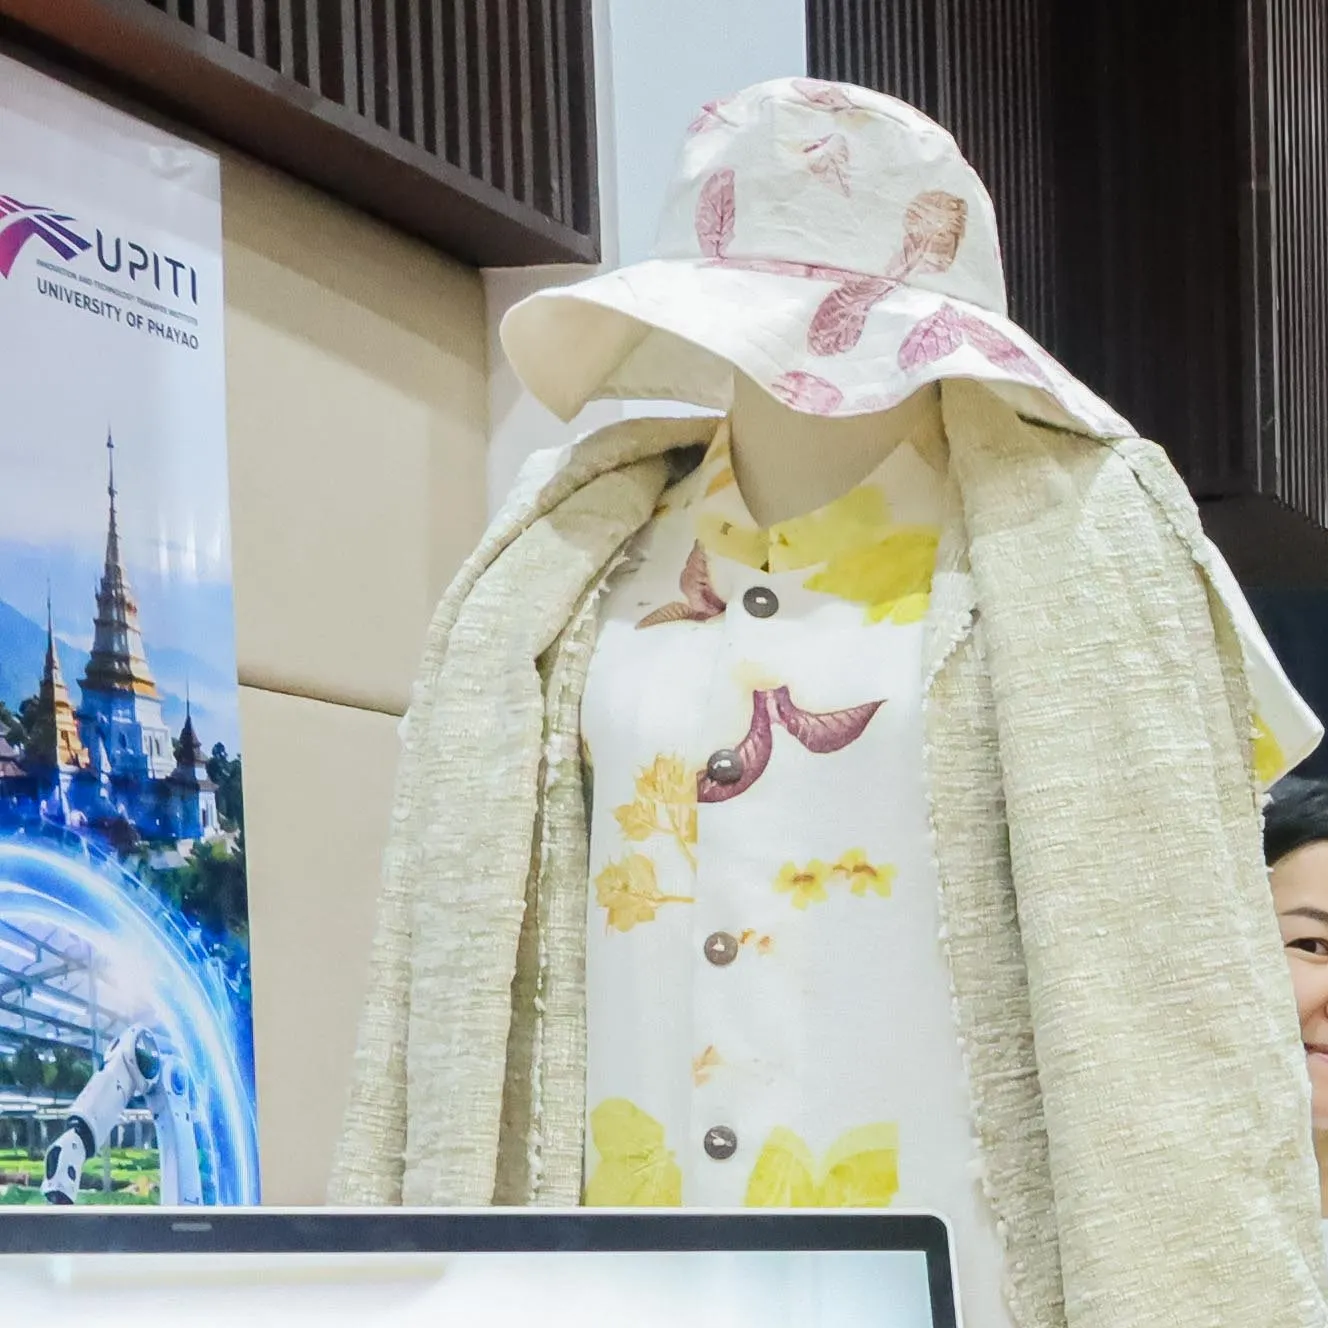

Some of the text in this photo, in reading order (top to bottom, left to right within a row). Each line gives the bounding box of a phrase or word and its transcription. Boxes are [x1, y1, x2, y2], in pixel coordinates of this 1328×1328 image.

[96, 228, 198, 305] UPITI
[36, 277, 199, 350] UNIVERSITY OF PHAYAO
